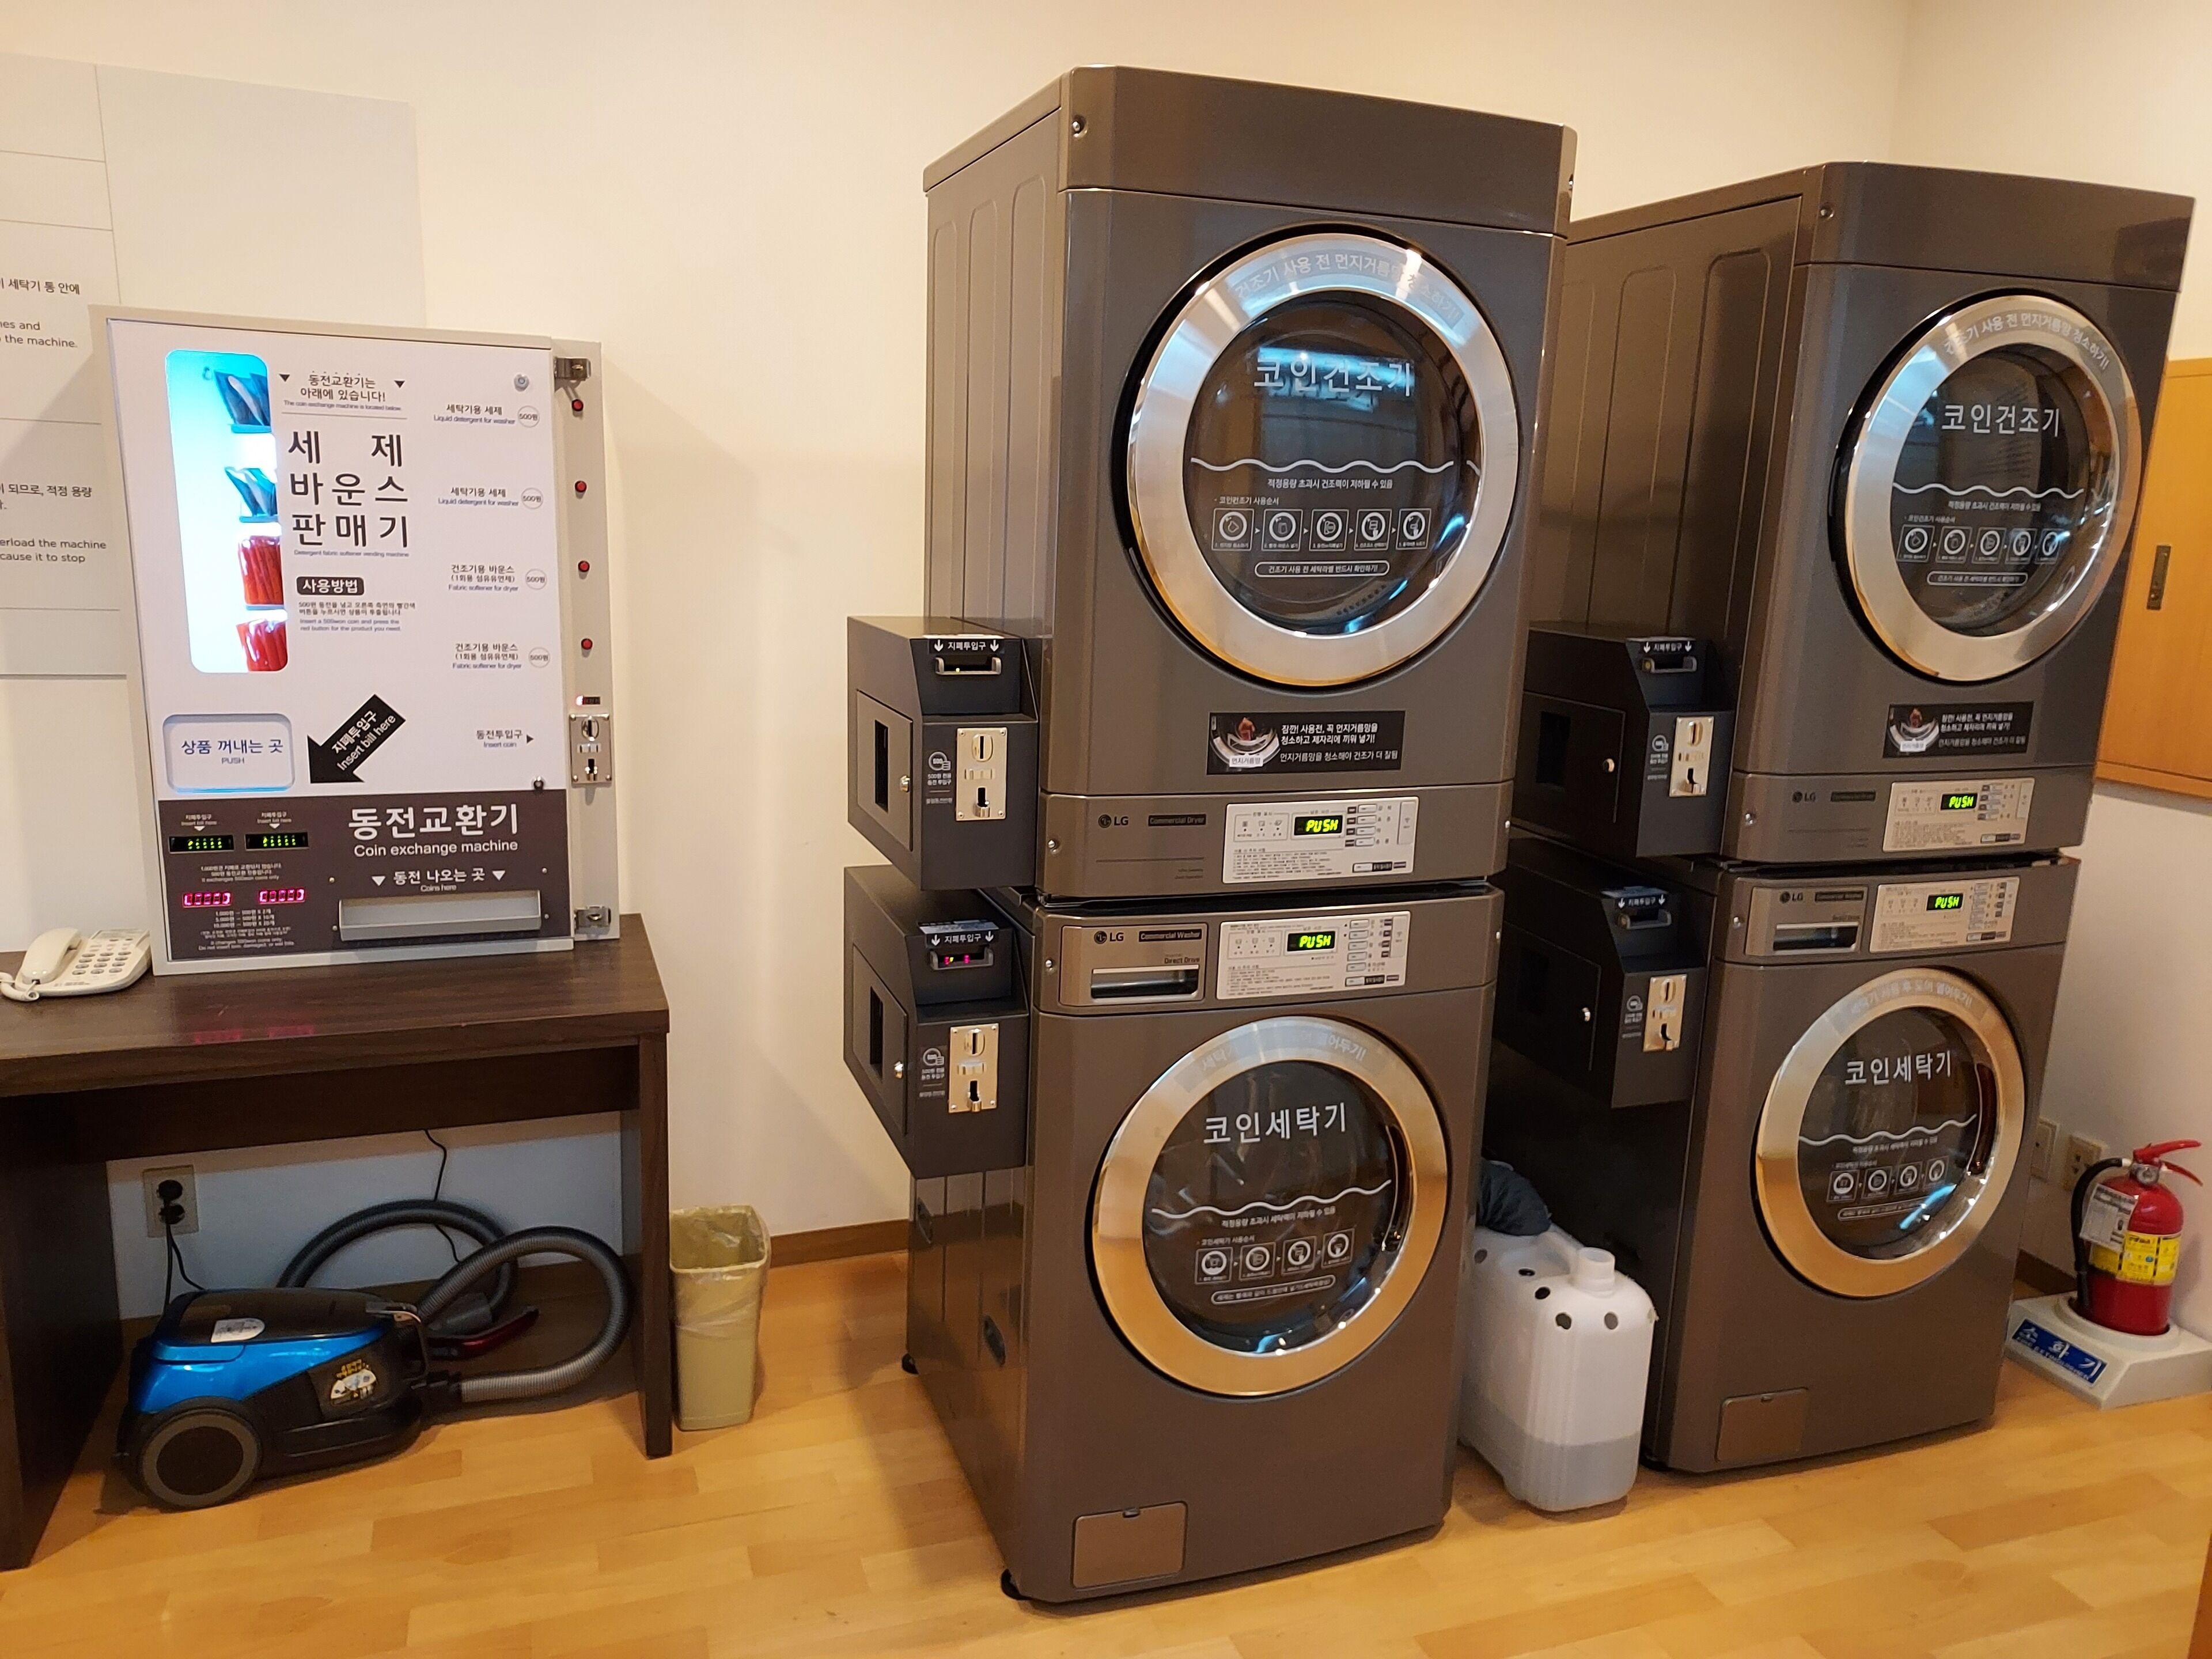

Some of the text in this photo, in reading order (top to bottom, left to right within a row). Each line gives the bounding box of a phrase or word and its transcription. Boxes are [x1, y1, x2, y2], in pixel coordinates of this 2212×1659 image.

[1284, 257, 1312, 278] 사용
[1316, 254, 1331, 269] 전
[8, 278, 80, 295] 세탁기 통 안에
[19, 321, 40, 331] and
[5, 334, 78, 348] the machine.
[308, 374, 376, 389] 동전교환기는
[1254, 358, 1410, 396] 코인건조기
[300, 388, 385, 402] 아래에 있습니다!
[446, 404, 502, 415] 세탁기용 세제
[1941, 404, 2060, 437] 코인건조기
[9, 483, 92, 498] 되므로, 적정 용량
[290, 472, 408, 506] 바운스
[488, 488, 506, 498] 세제
[292, 513, 408, 548] 판매기
[39, 538, 56, 548] the
[60, 540, 107, 550] machine
[35, 552, 43, 561] it
[46, 553, 58, 562] to
[61, 554, 86, 564] stop
[302, 579, 358, 594] 사용방법
[948, 642, 986, 650] 지폐투입구
[331, 710, 378, 755] 지폐투입구
[476, 729, 523, 740] 동전투입구
[181, 738, 283, 755] 상품 꺼내는 곳
[336, 747, 365, 771] Insert
[374, 714, 396, 738] here
[1804, 792, 1816, 802] LG
[1949, 796, 1974, 808] PUSH
[348, 803, 518, 841] 동전교환기
[1114, 816, 1128, 825] LG
[1306, 819, 1339, 832] PUSH
[354, 839, 518, 857] Coin exchange machine
[393, 868, 485, 885] 동전 나오는 곳
[1791, 892, 1803, 902] LG
[1934, 897, 1960, 908] PUSH
[944, 934, 982, 944] 지폐투입구
[1109, 933, 1124, 941] LG
[1299, 934, 1331, 948] PUSH
[1844, 1051, 1951, 1085] 코인세탁기
[1203, 1102, 1346, 1144] 코인세탁기
[2018, 1327, 2102, 1377] 소화기
